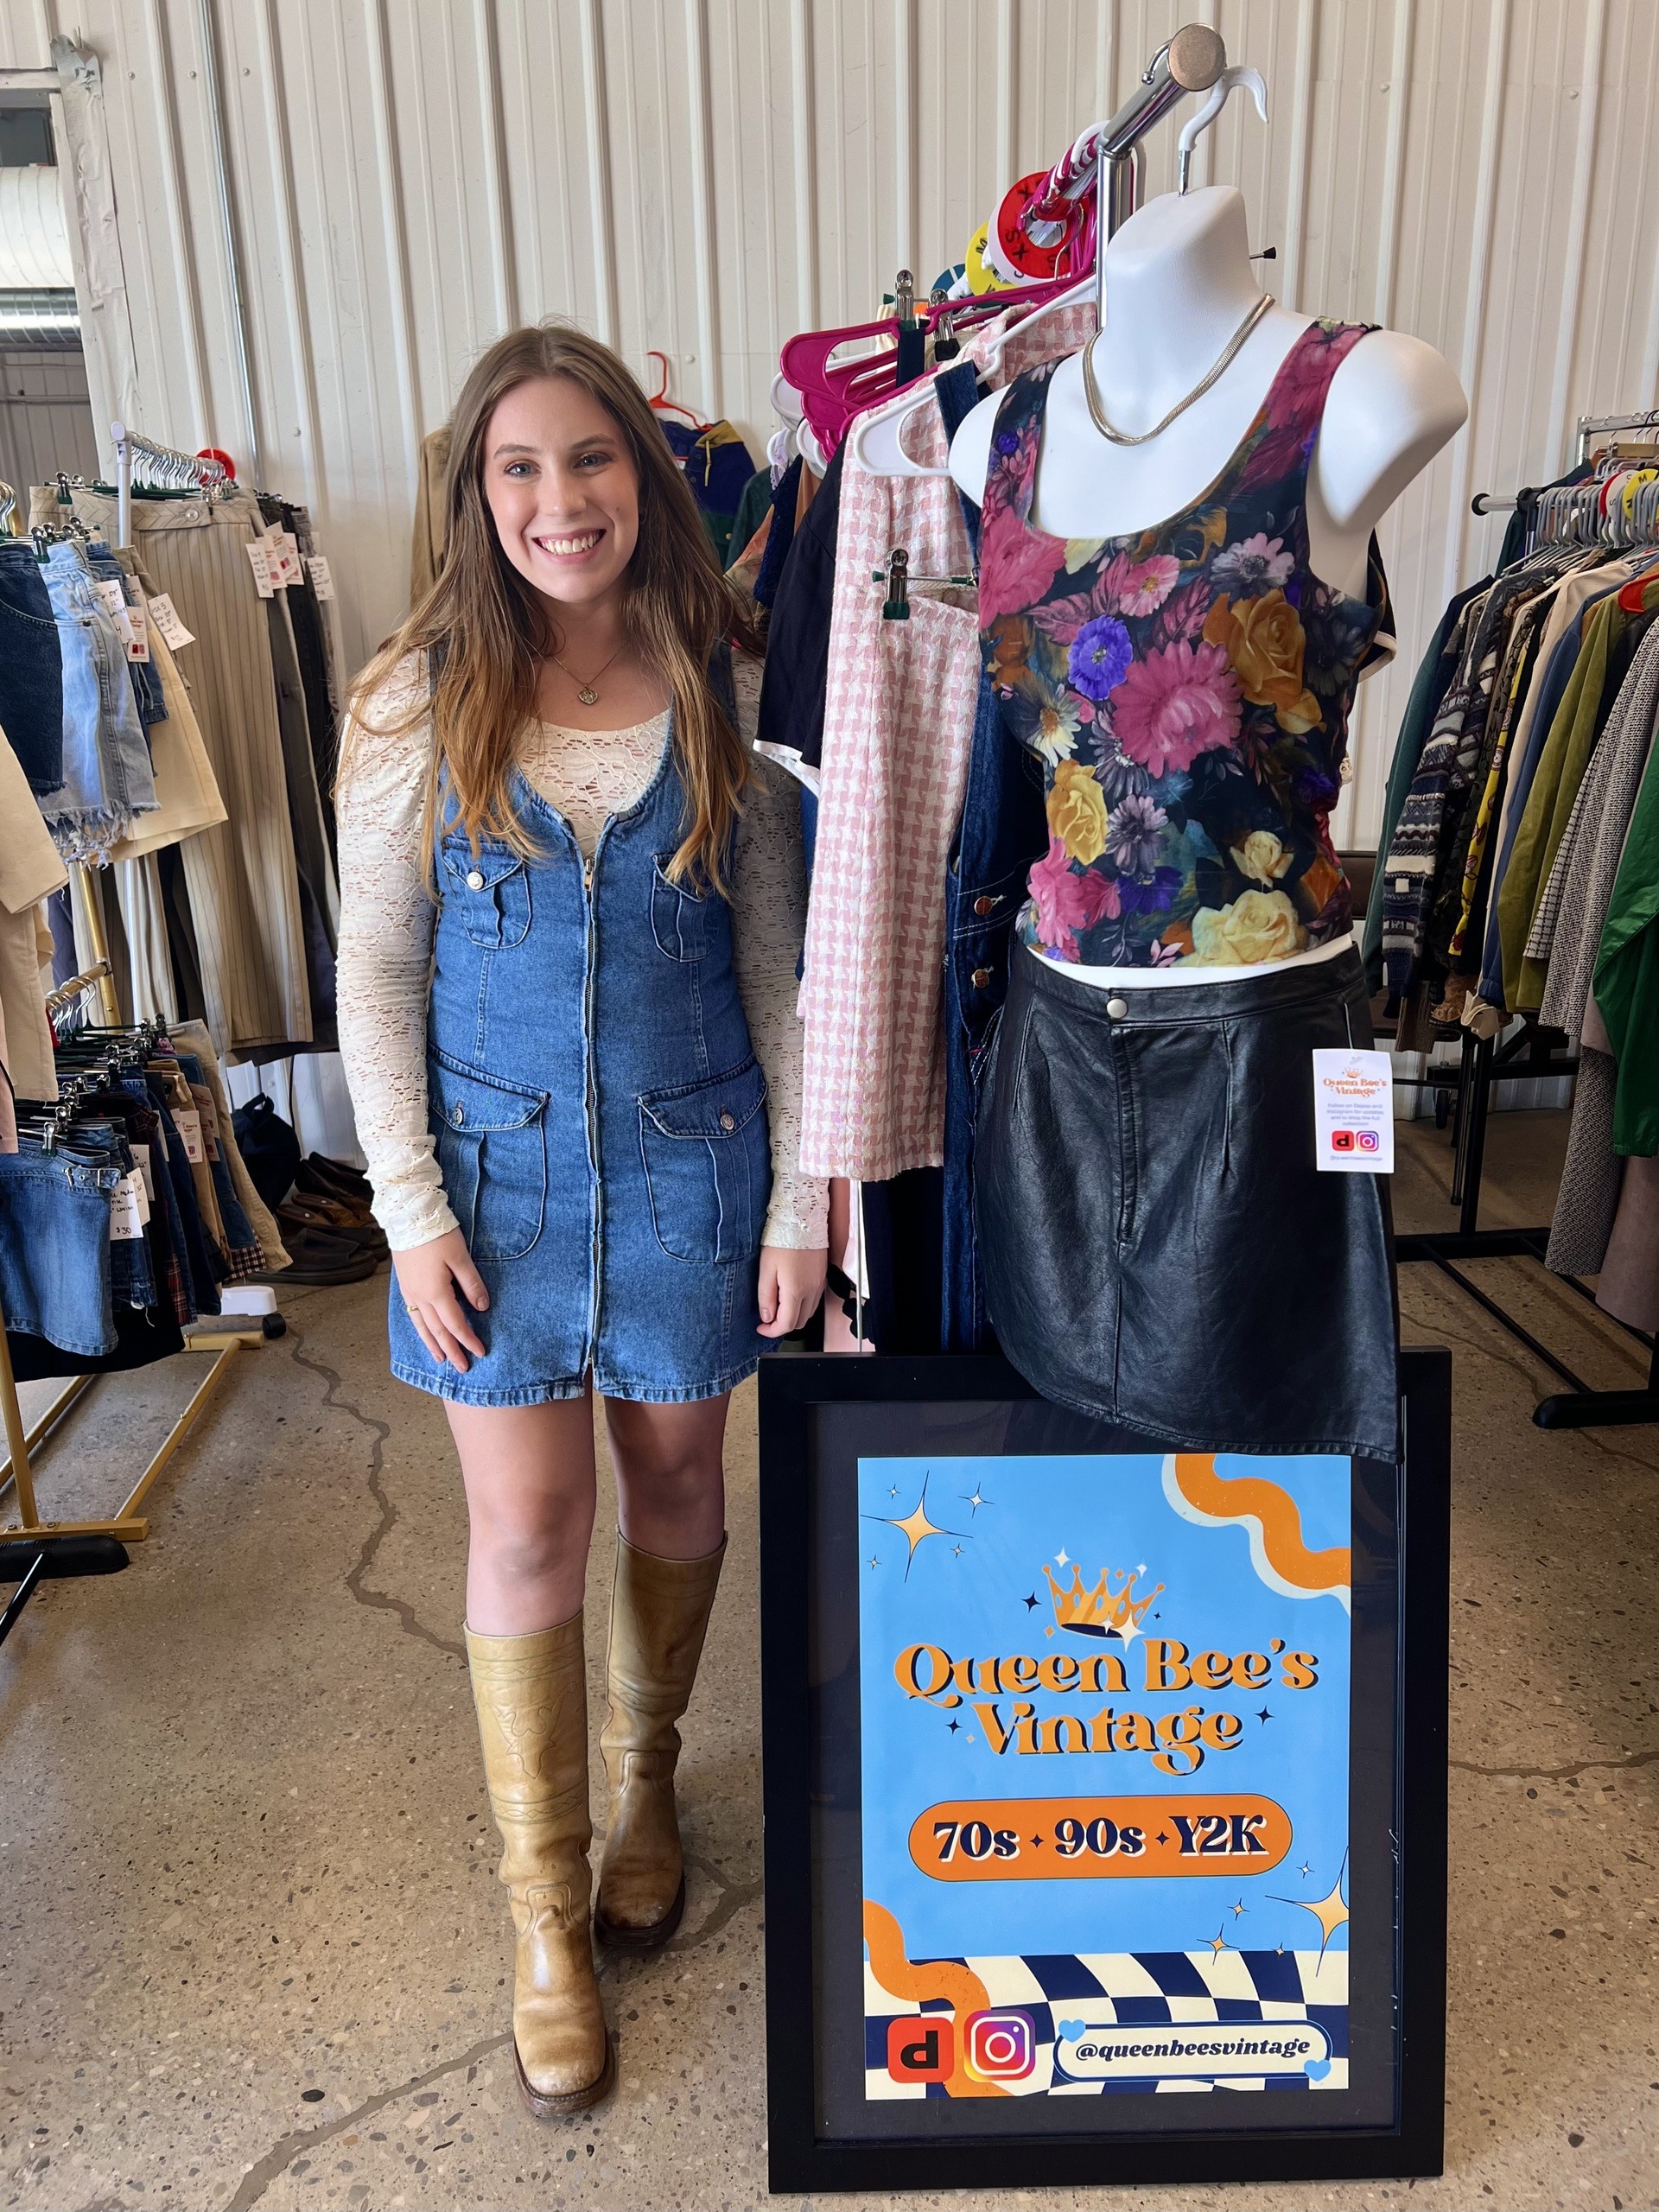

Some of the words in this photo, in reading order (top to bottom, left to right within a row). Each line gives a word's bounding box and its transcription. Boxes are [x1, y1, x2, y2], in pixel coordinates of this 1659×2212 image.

[1323, 1078, 1358, 1087] Queen
[1360, 1078, 1388, 1087] Bee's
[1335, 1087, 1376, 1098] Vintage
[115, 1226, 132, 1235] $30
[894, 1643, 1128, 1707] Queen
[1142, 1638, 1319, 1691] Bee's
[969, 1702, 1243, 1776] Vintage
[932, 1821, 1020, 1863] 70s
[1054, 1817, 1146, 1857] 90s
[1170, 1814, 1268, 1856] Y2K
[1076, 2037, 1310, 2064] @queenbeesvintage
